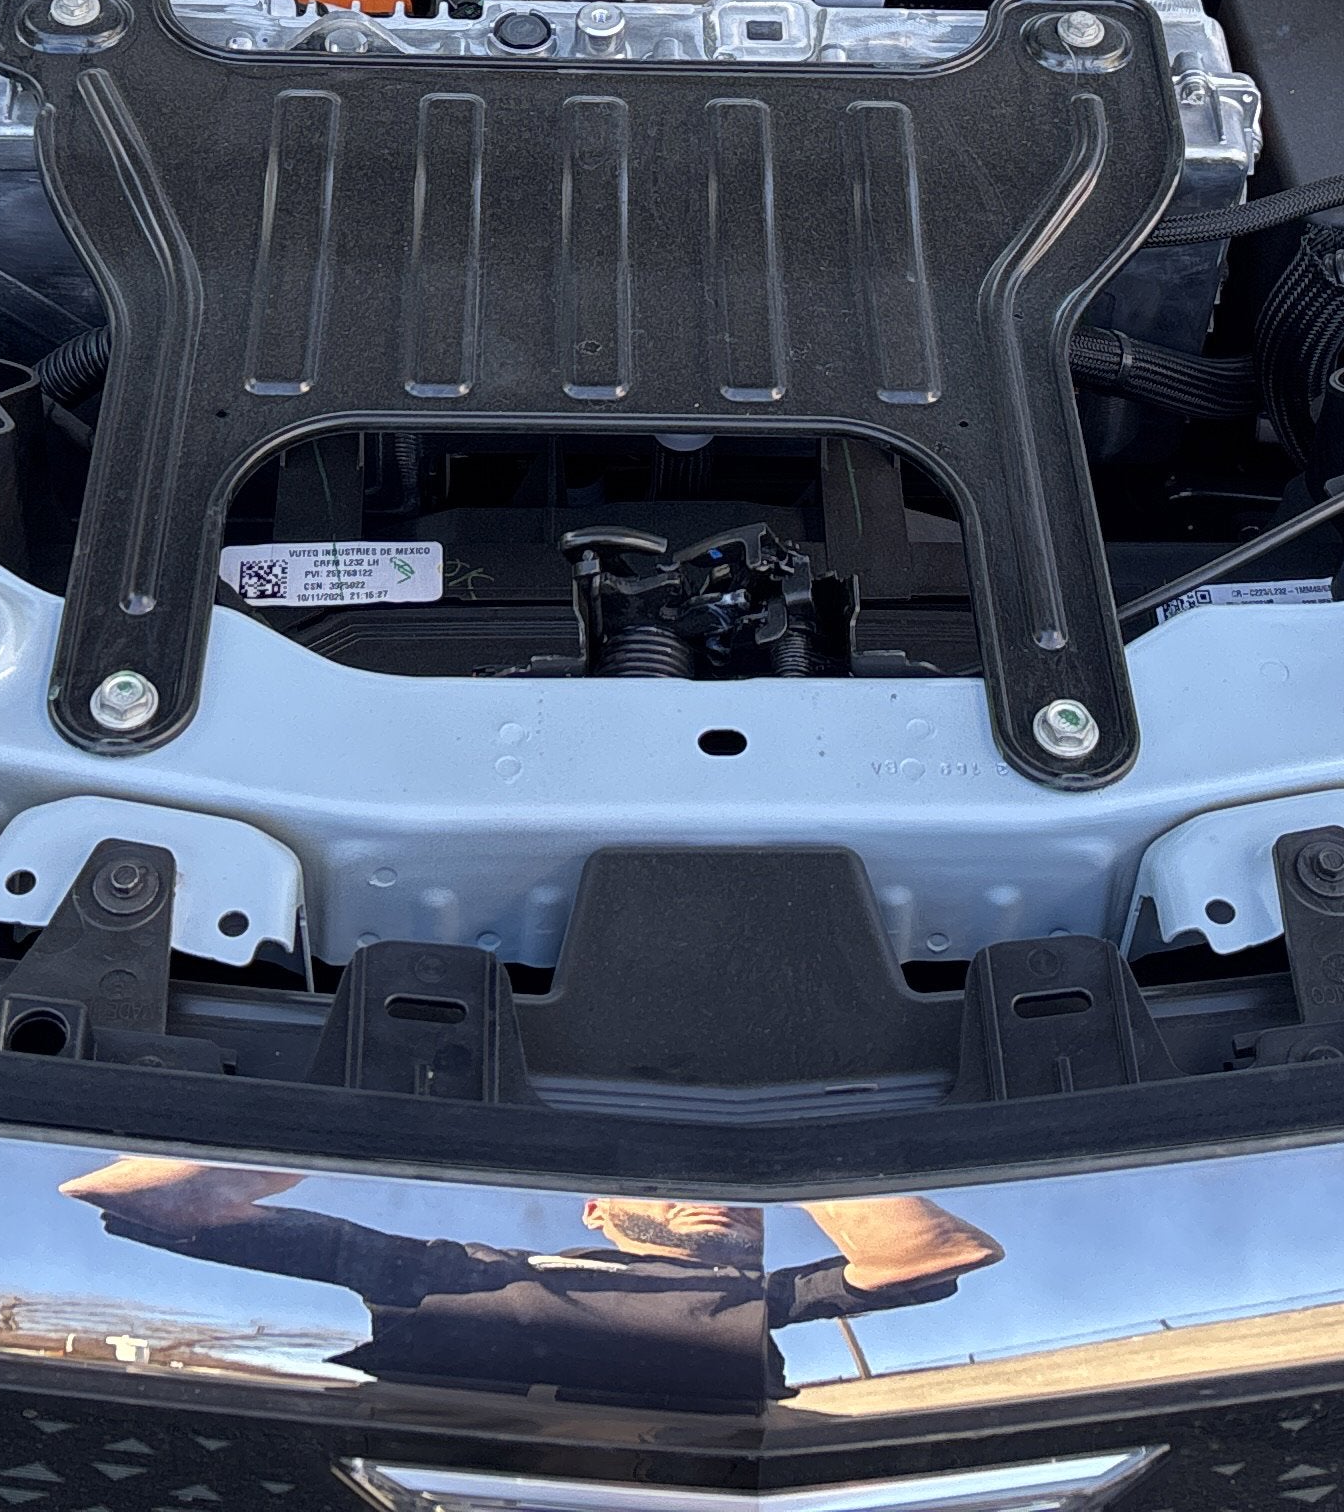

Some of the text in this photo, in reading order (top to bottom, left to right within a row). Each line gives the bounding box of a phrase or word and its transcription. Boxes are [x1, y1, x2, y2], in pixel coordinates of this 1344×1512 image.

[288, 546, 431, 558] VUTEQ INDUSTRIES DE MEXICO
[343, 558, 365, 567] L232
[367, 558, 380, 566] LH
